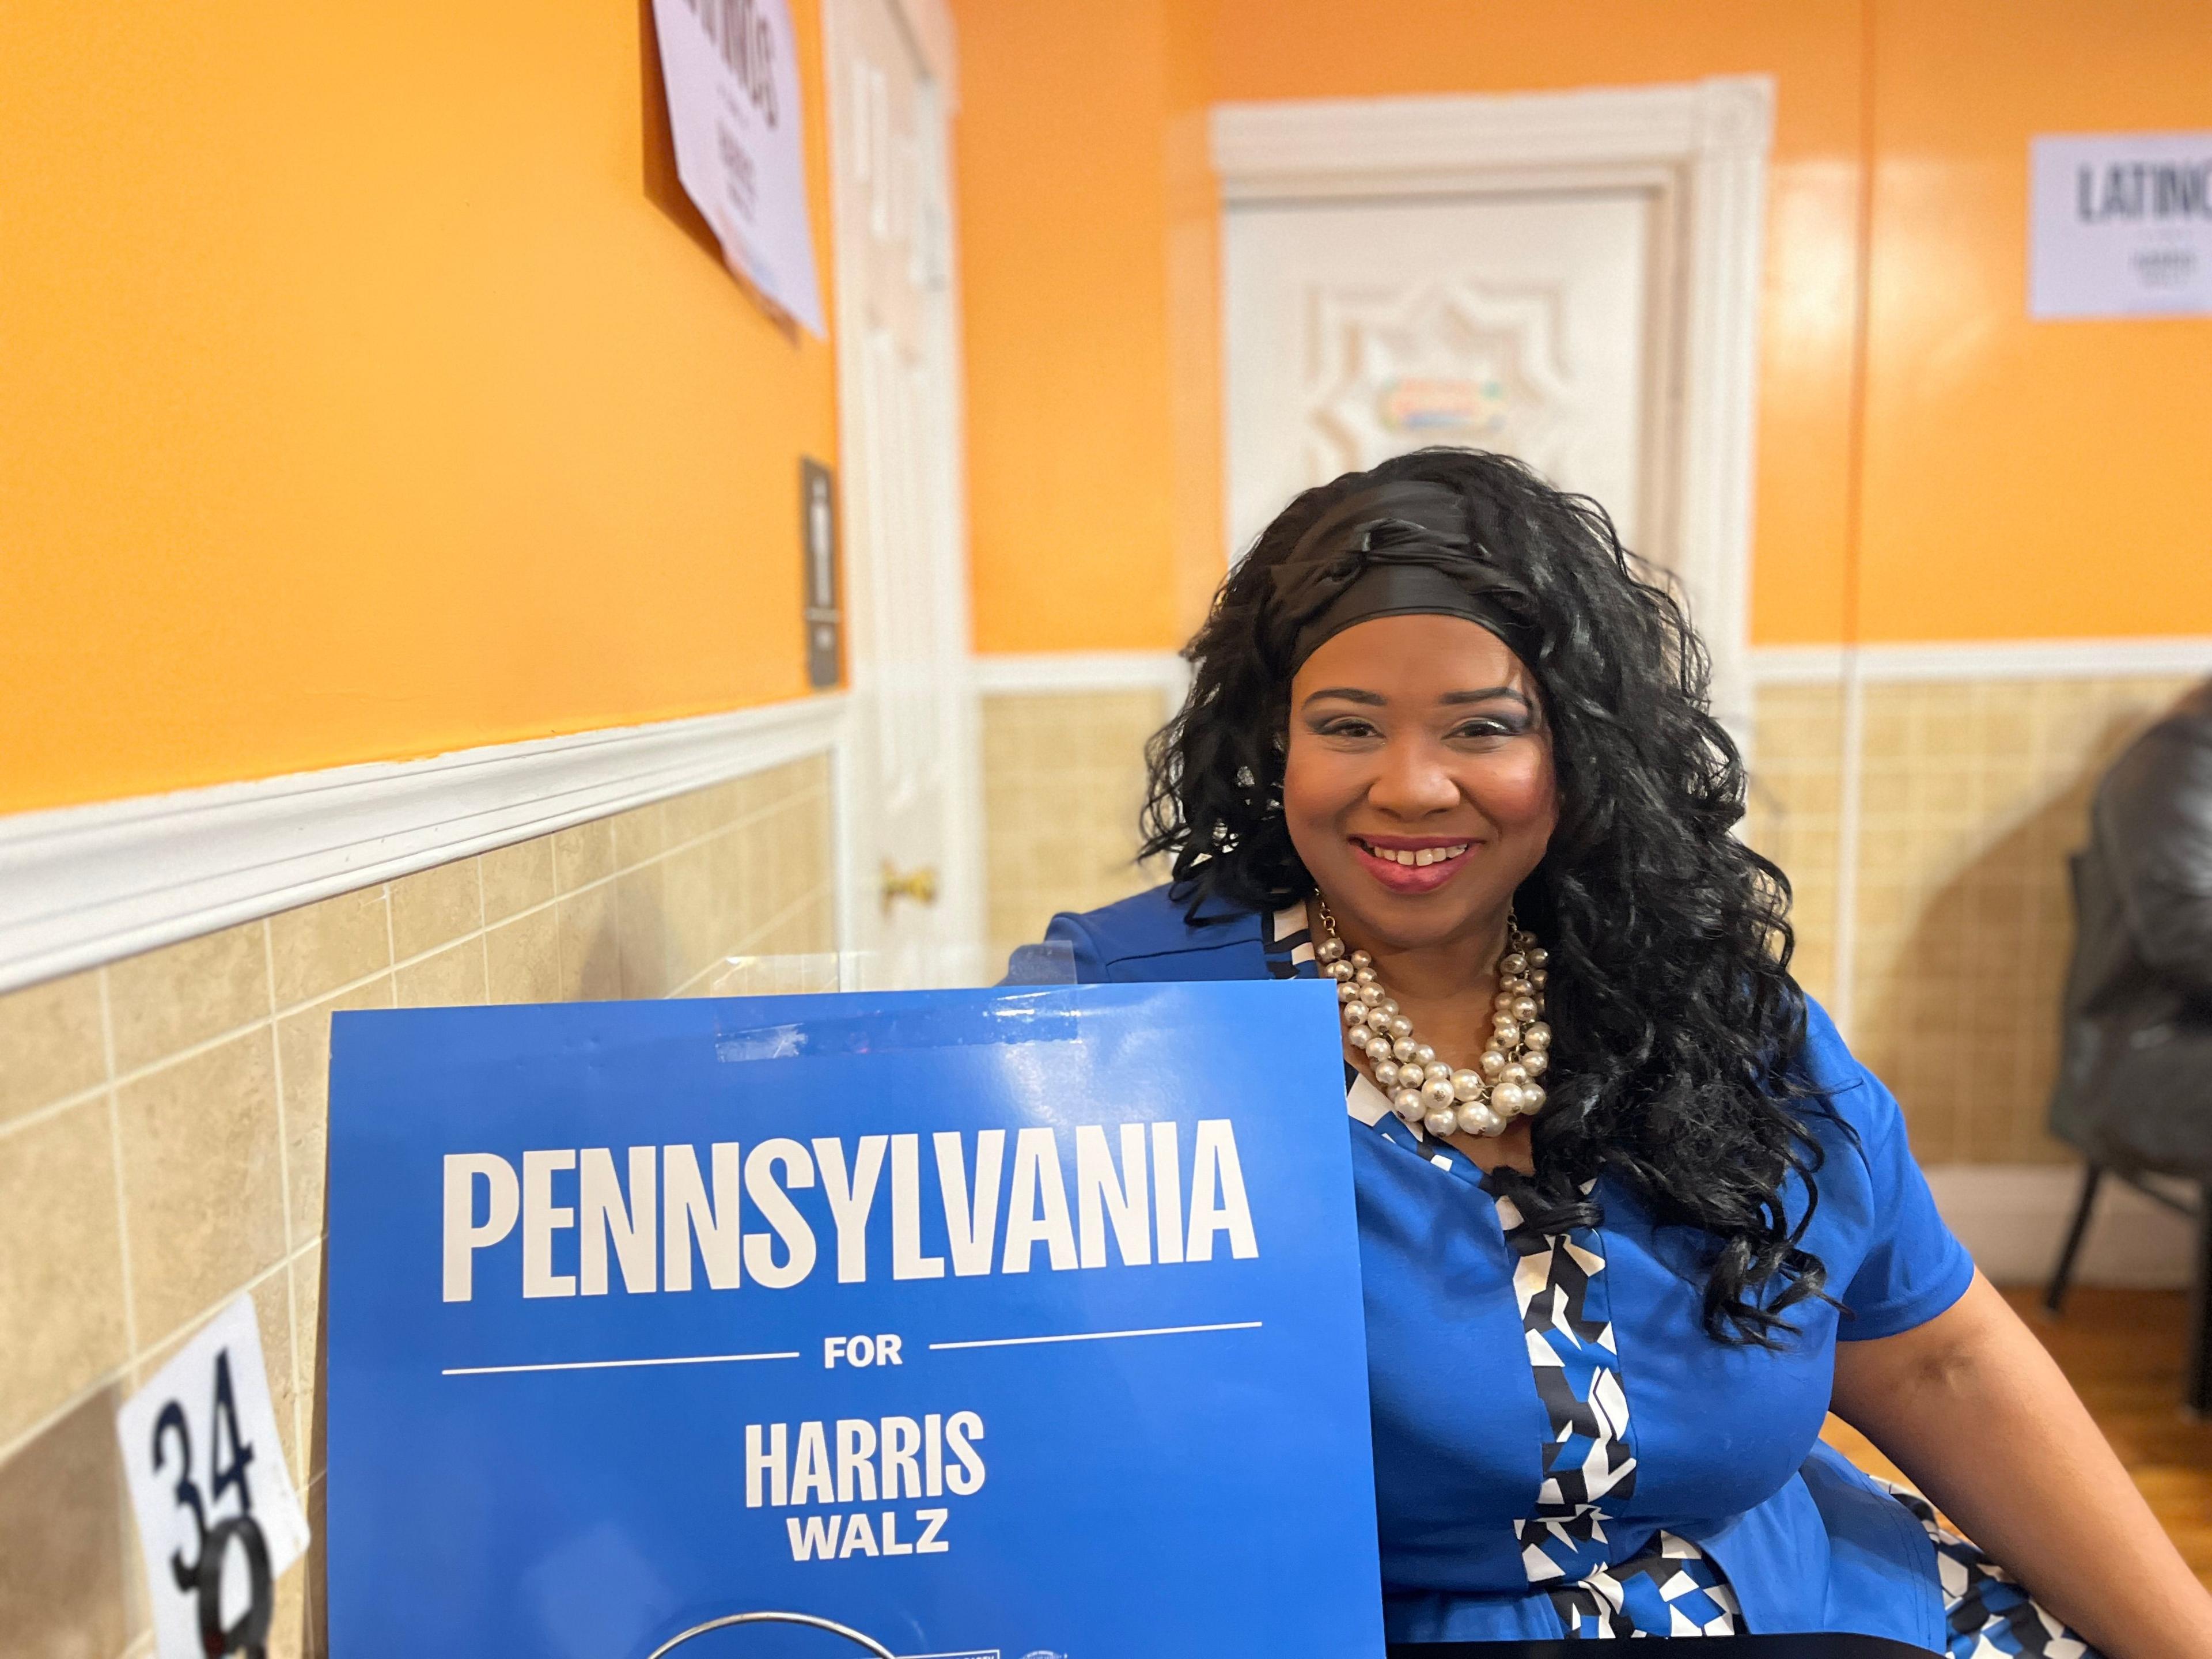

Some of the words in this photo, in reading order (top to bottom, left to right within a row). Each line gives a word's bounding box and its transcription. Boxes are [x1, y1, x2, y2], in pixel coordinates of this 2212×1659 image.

[442, 1118, 1259, 1302] PENNSYLVANIA
[824, 1334, 903, 1369] FOR
[152, 1345, 255, 1593] 34
[745, 1411, 986, 1508] HARRIS
[786, 1508, 949, 1561] WALZ
